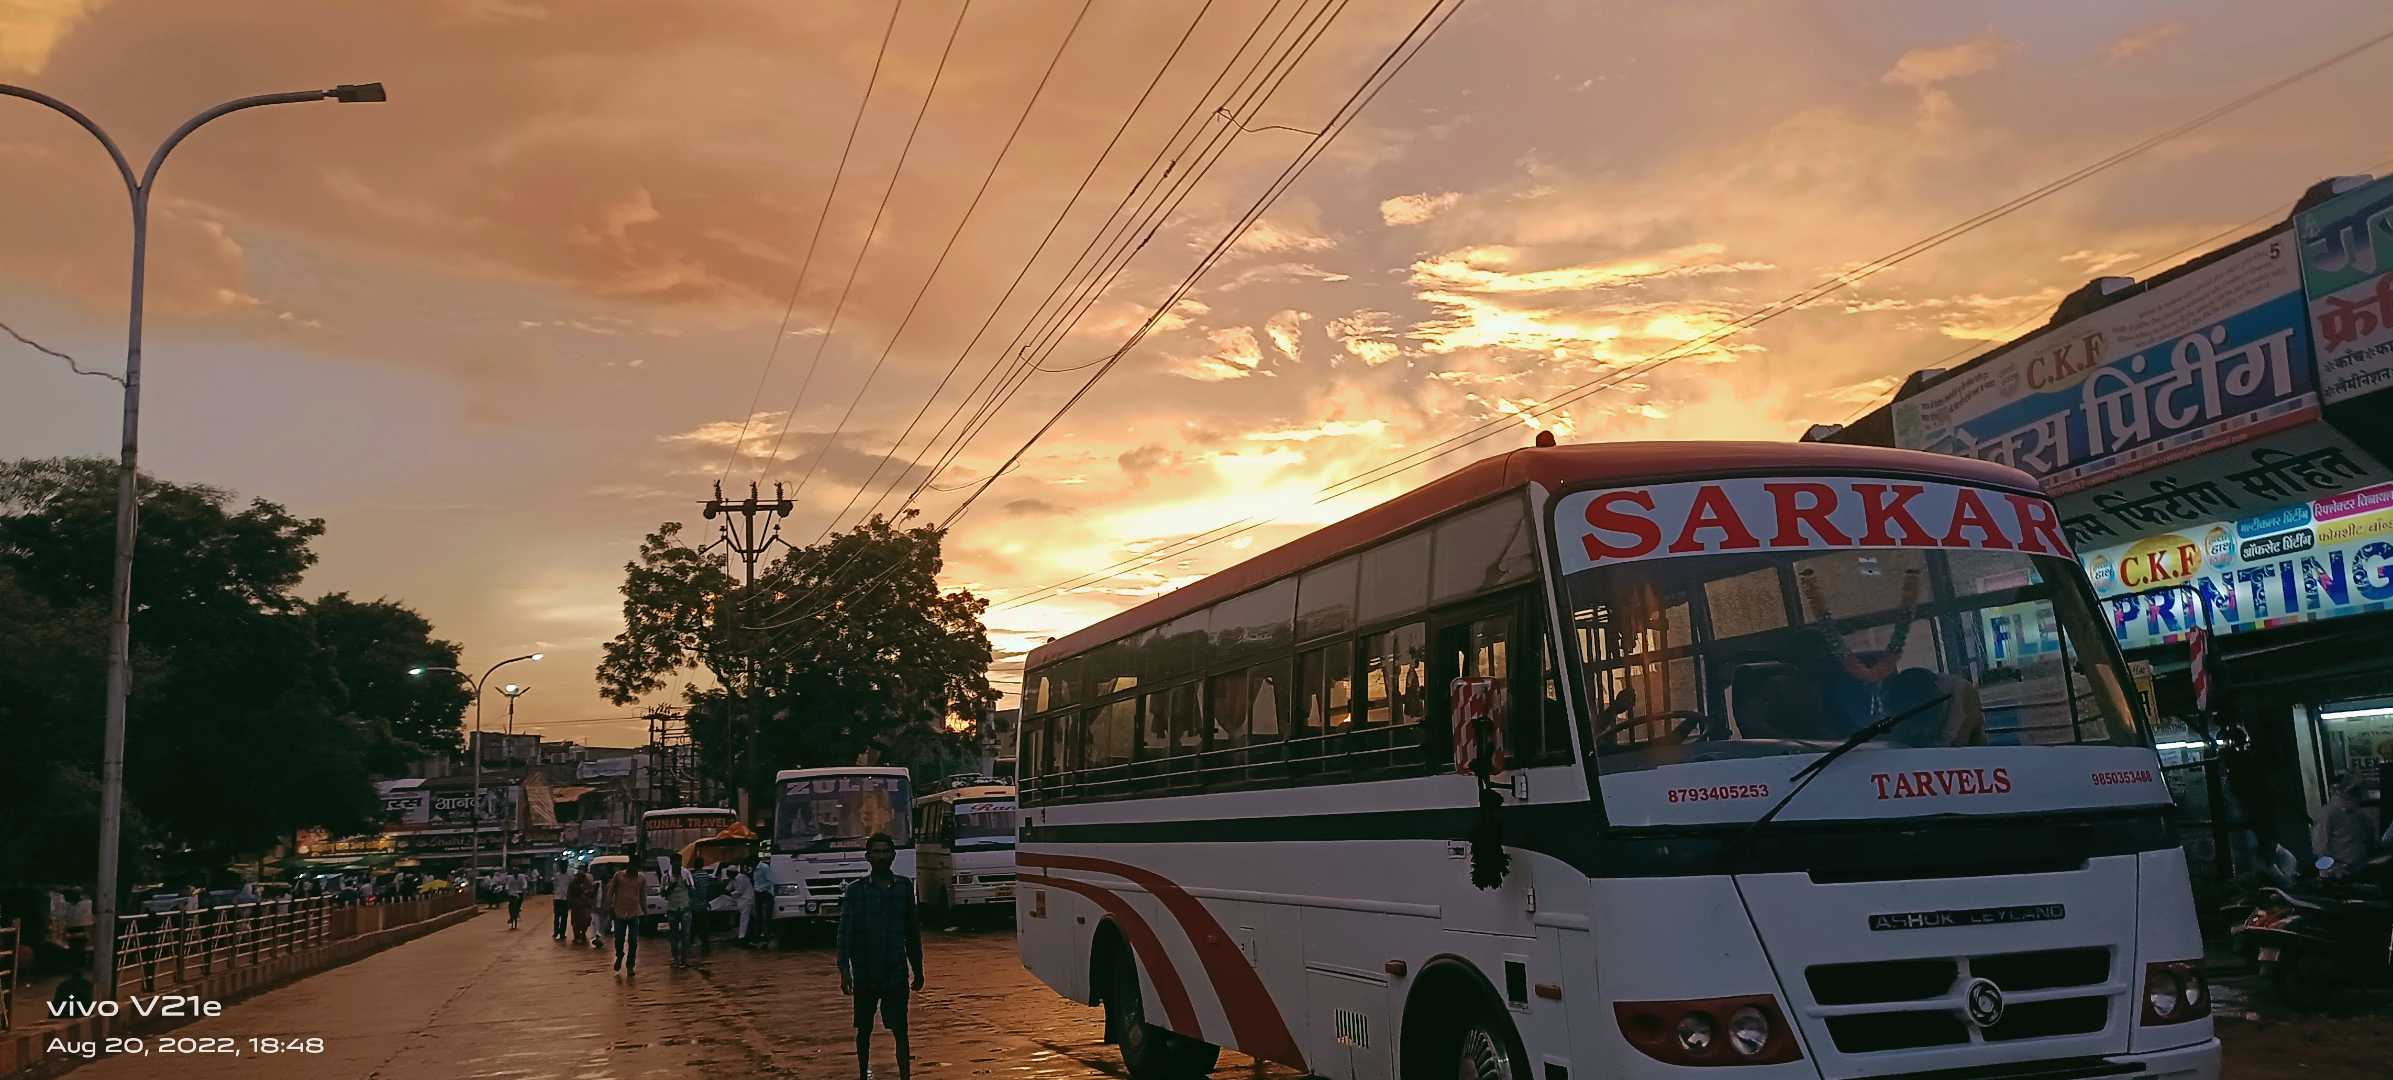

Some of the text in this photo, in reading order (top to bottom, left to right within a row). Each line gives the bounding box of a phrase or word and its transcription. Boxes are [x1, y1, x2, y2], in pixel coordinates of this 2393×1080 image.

[2270, 242, 2282, 260] 5
[1582, 483, 2073, 560] SARKAR
[2119, 543, 2197, 588] C.K.F
[2111, 540, 2393, 640] PRINTING
[1668, 784, 1769, 803] 8793405253
[1872, 768, 2012, 800] TARVELS
[1970, 904, 2065, 923] LEYLAND
